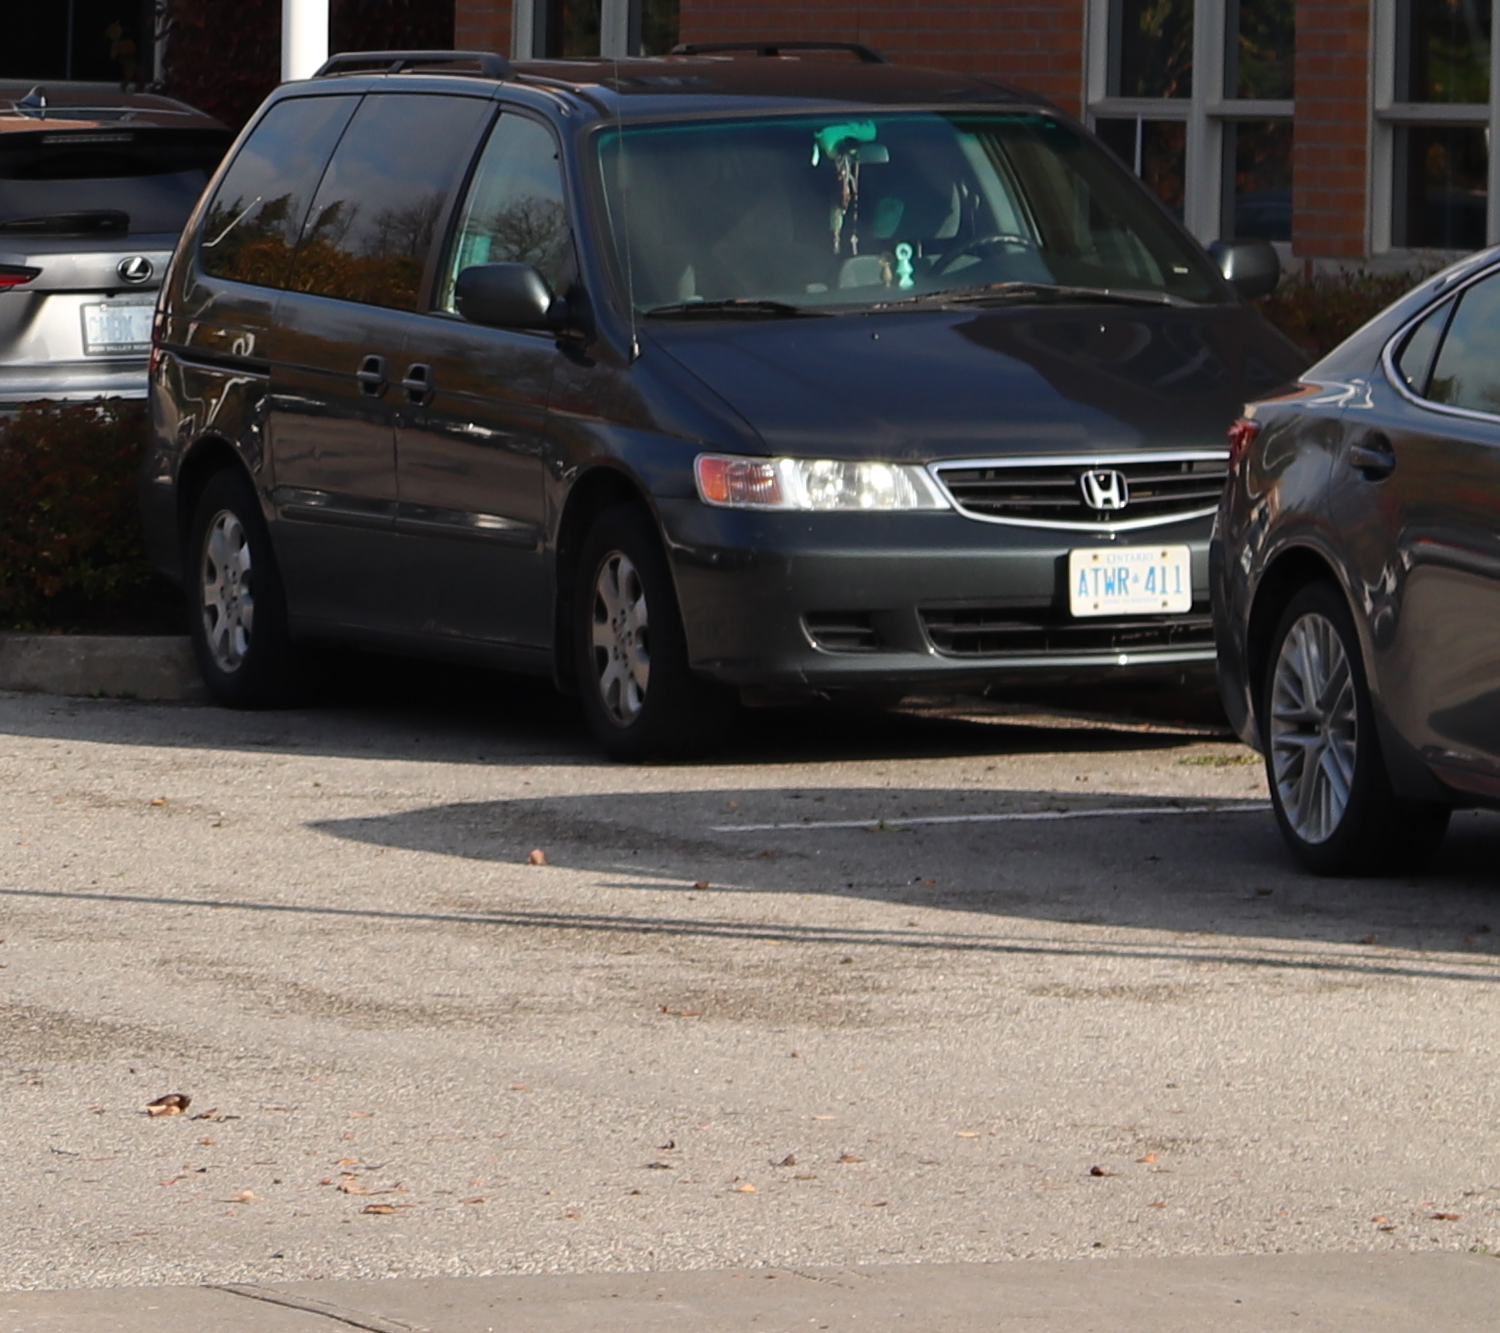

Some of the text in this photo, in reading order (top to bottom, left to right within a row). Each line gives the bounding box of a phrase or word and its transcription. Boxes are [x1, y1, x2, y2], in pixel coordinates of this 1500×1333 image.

[1106, 552, 1154, 564] ONTARIO
[1078, 564, 1184, 597] ATWR 411
